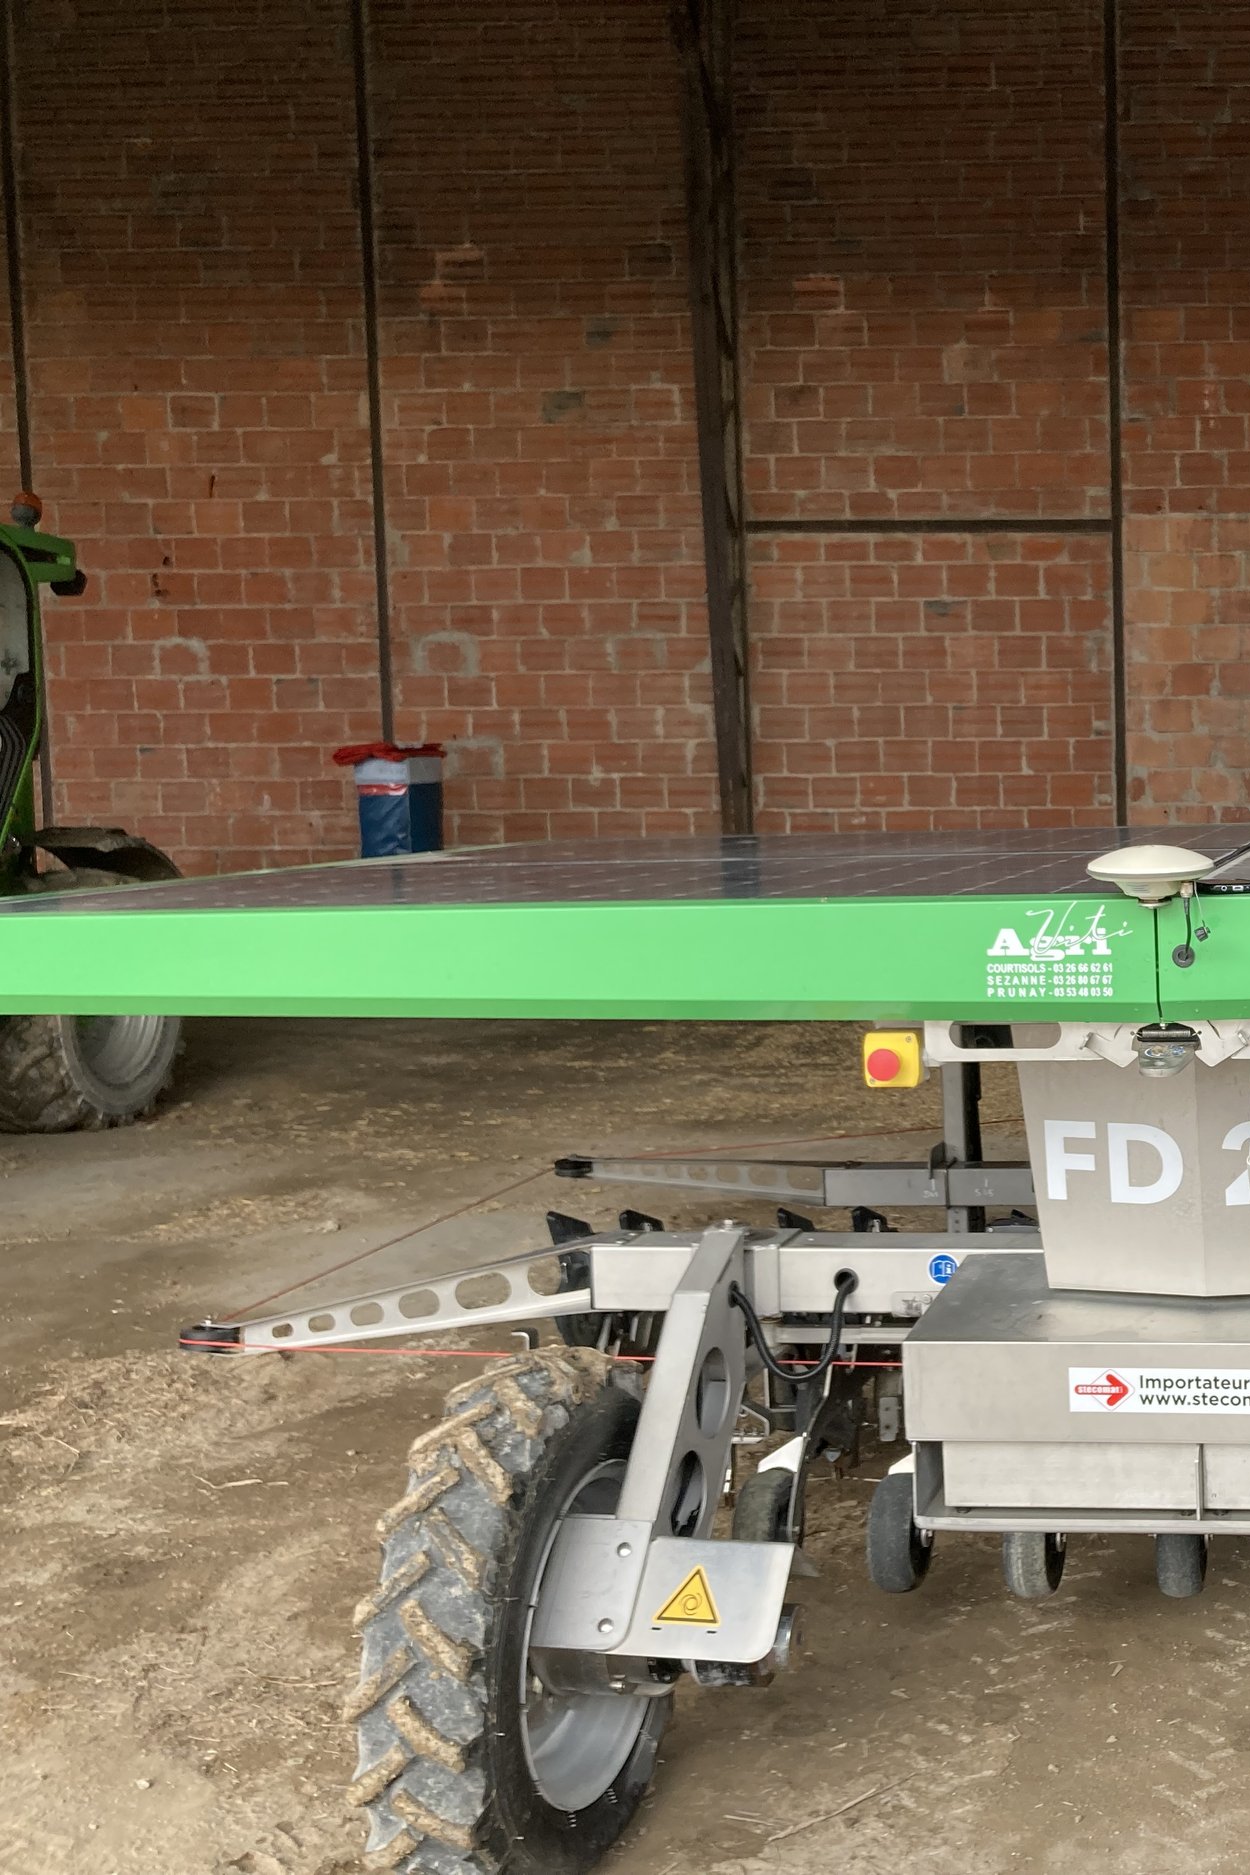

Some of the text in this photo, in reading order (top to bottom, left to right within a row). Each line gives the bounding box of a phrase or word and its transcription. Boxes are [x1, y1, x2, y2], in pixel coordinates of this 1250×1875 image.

[987, 928, 1112, 961] Agri
[987, 963, 1046, 973] COURTISOLS
[1053, 963, 1063, 972] 03
[1065, 963, 1076, 972] 26
[1078, 963, 1089, 972] 66
[1090, 963, 1101, 972] 62
[1102, 963, 1112, 972] 61
[987, 975, 1046, 985] SEZANNE
[1053, 975, 1063, 985] 03
[1065, 975, 1076, 985] 26
[1078, 975, 1088, 985] 80
[1090, 975, 1100, 985] 67
[1102, 975, 1112, 985] 67
[987, 987, 1046, 997] PRUNAY
[1054, 987, 1065, 997] 03
[1066, 987, 1077, 997] 53
[1078, 987, 1089, 997] 48
[1090, 987, 1101, 997] 03
[1103, 987, 1113, 997] 50
[1044, 1119, 1183, 1205] FD
[1139, 1375, 1250, 1392] Importateur
